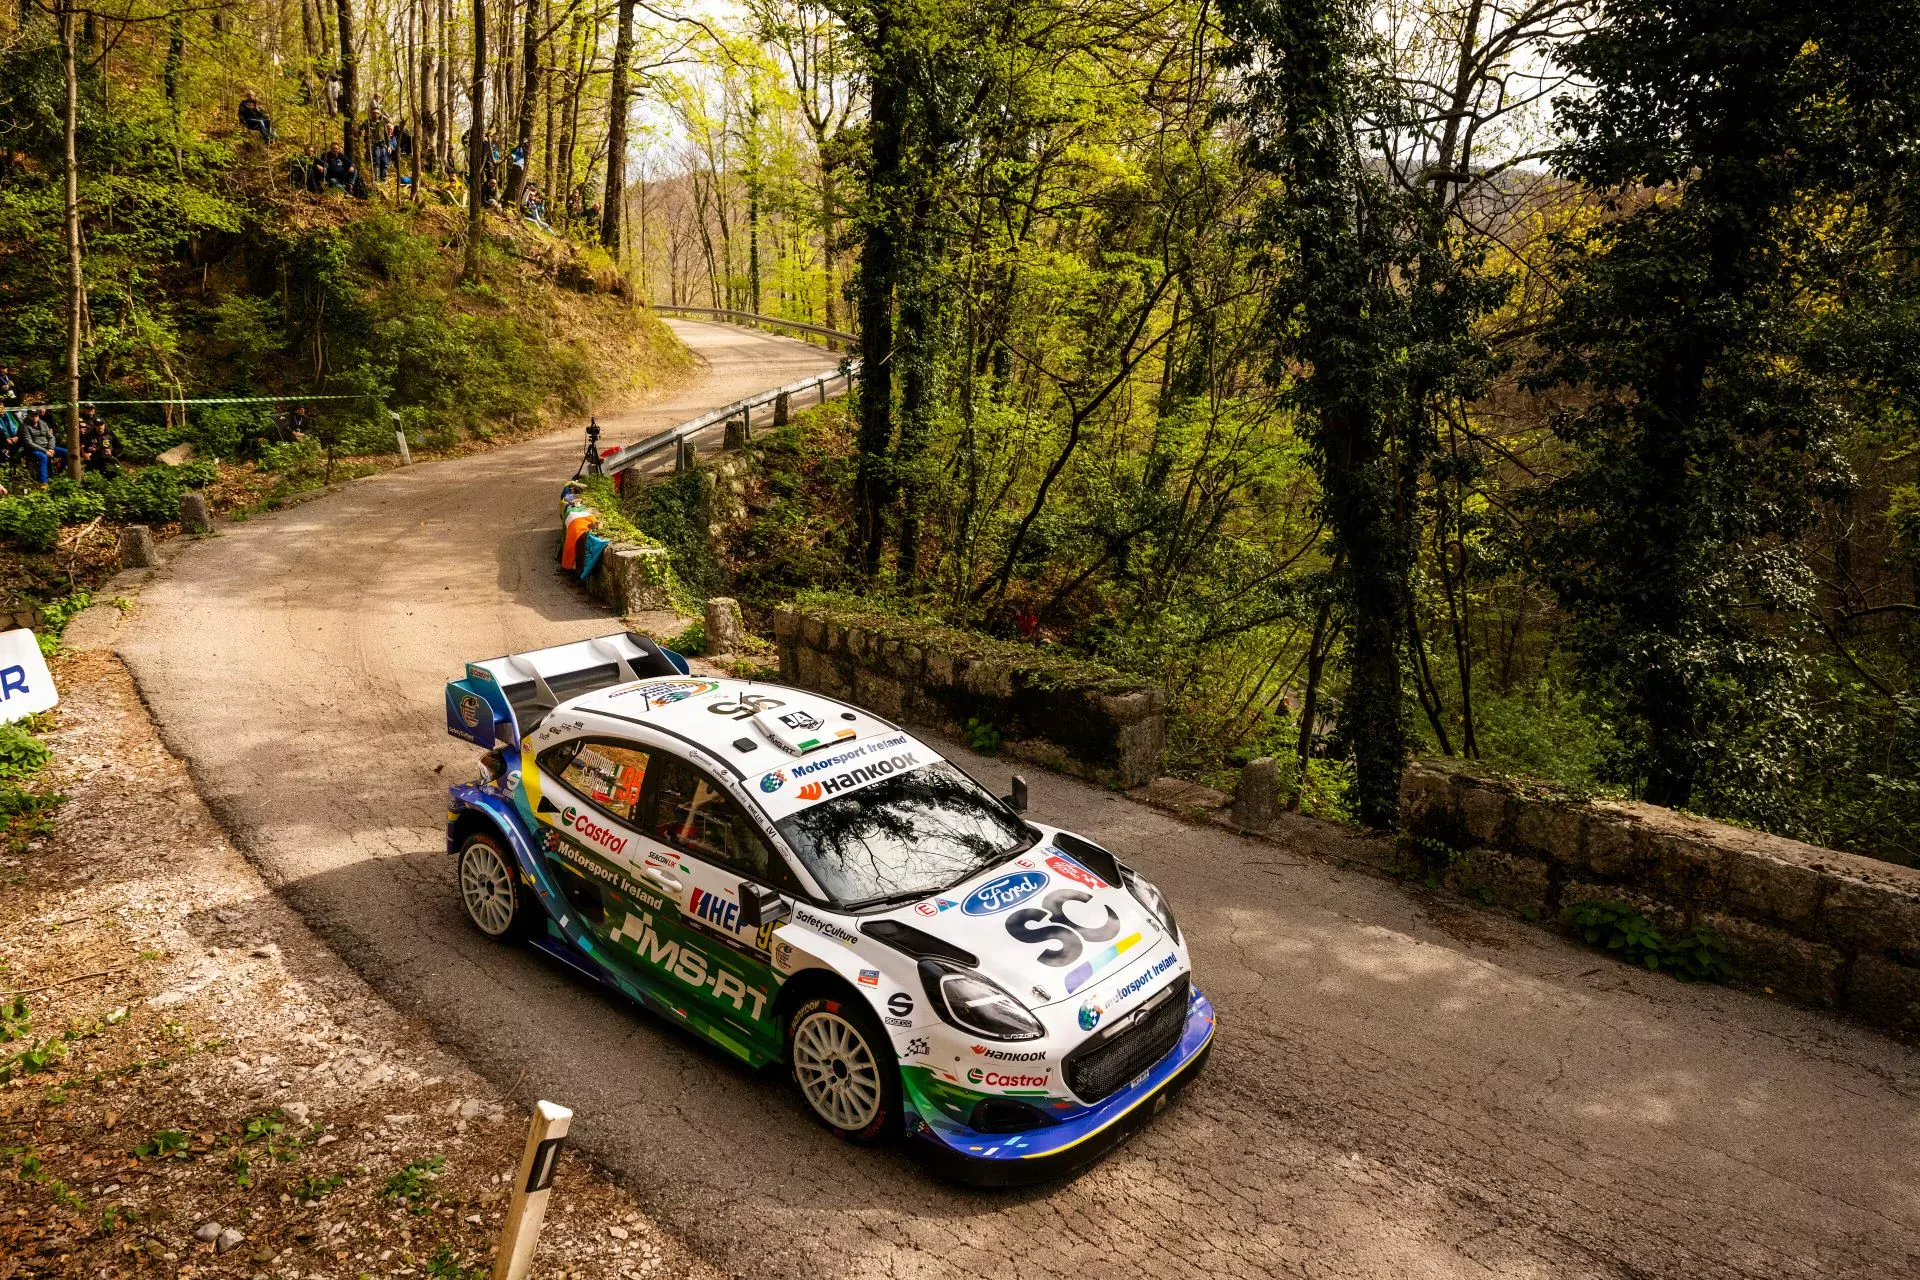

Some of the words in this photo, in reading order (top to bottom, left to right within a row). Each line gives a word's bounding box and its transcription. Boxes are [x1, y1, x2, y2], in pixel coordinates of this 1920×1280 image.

[0, 664, 30, 701] R
[791, 747, 867, 779] Motorsport
[866, 735, 907, 754] Ireland
[575, 815, 628, 854] Castrol
[558, 841, 619, 886] Motorsport
[620, 878, 663, 911] Ireland
[977, 876, 1039, 910] Ford
[796, 910, 858, 945] SafetyCulture
[1152, 952, 1178, 977] Ireland
[985, 1071, 1049, 1087] Castrol
